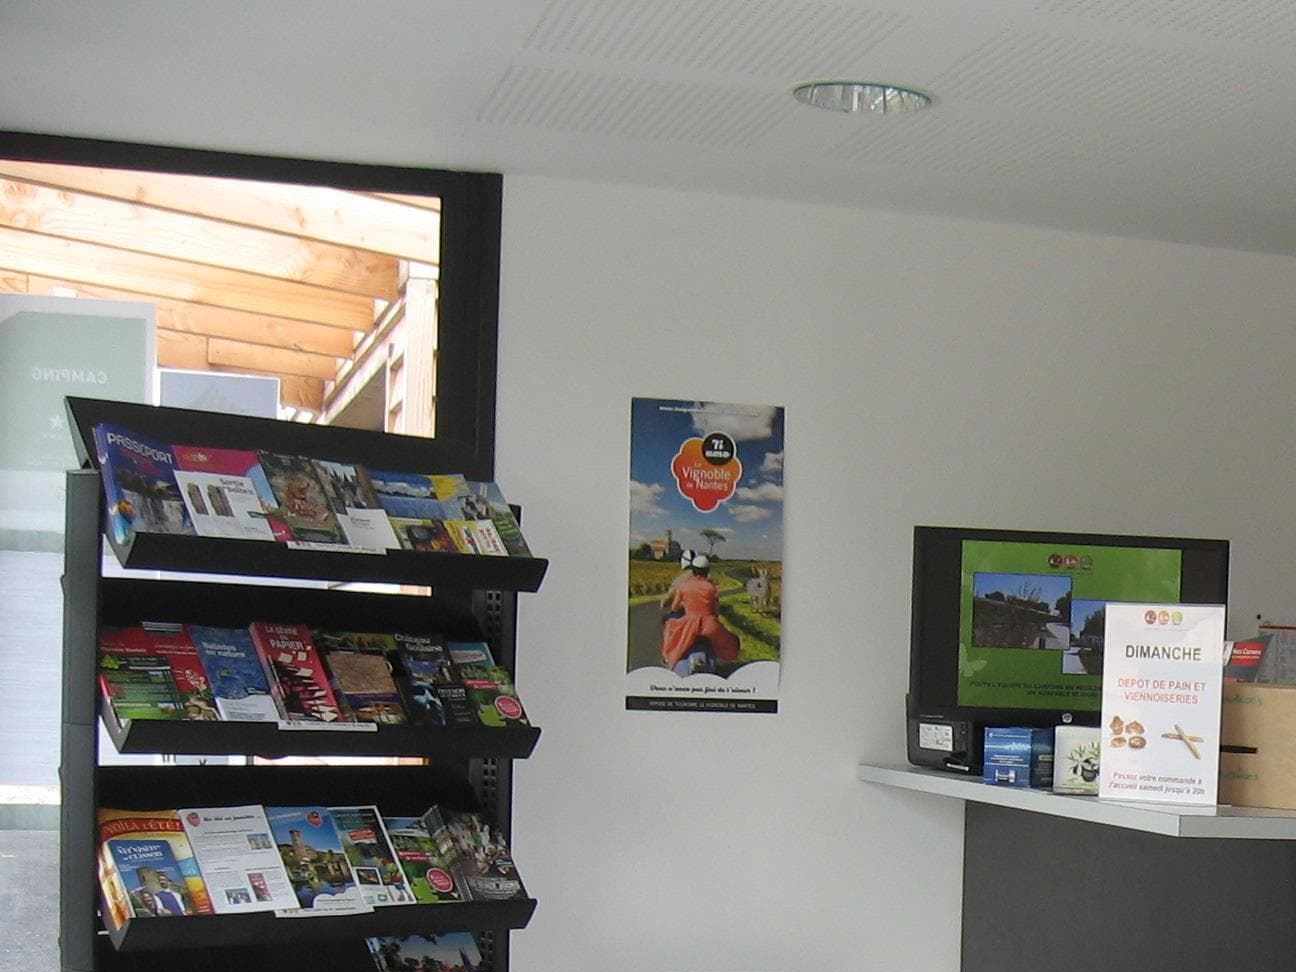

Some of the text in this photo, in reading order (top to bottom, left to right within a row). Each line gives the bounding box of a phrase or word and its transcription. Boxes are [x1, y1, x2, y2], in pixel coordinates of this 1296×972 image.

[106, 432, 174, 465] PASSEPORT
[682, 466, 732, 482] Vignoble
[696, 479, 728, 490] Nantes
[1125, 645, 1202, 661] DIMANCHE
[1117, 678, 1206, 692] DEPOT DE PAIN ET
[1124, 691, 1199, 704] VIENNOISERIES
